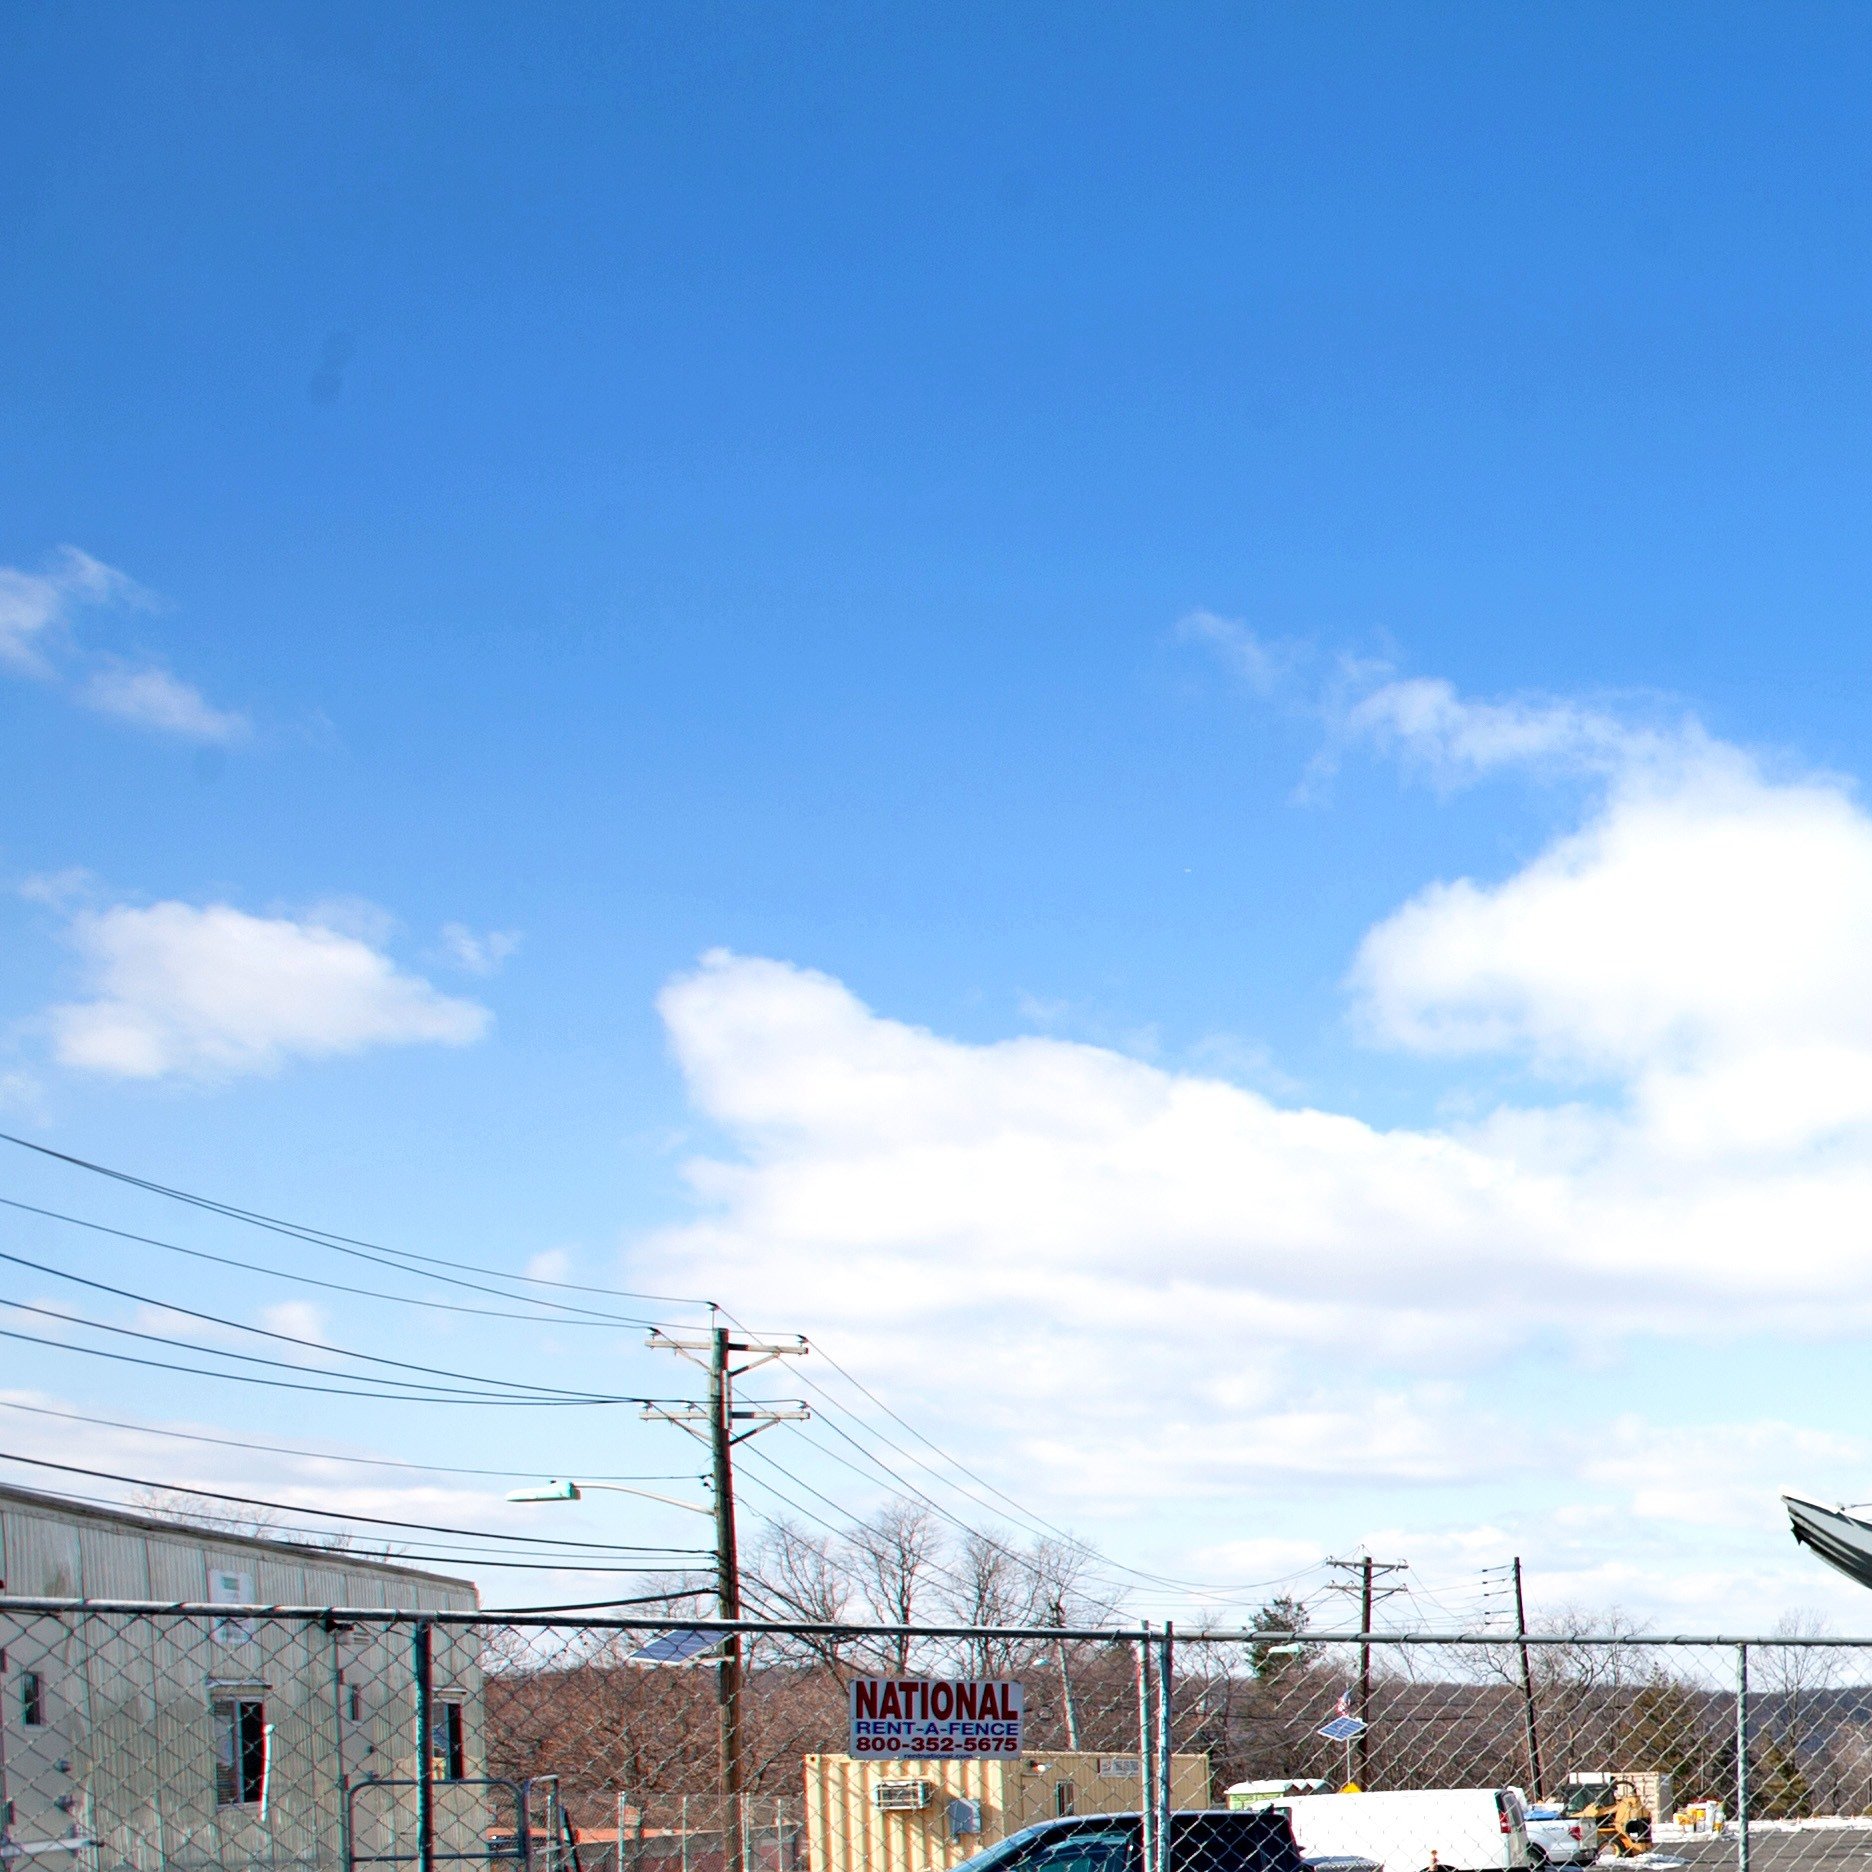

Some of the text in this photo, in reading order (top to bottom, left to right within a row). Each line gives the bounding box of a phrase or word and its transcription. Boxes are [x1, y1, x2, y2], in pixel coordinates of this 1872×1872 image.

[856, 1681, 1018, 1720] NATIONAL
[856, 1721, 1019, 1735] RENT-A-FENCE
[856, 1737, 1018, 1751] 800-352-5675
